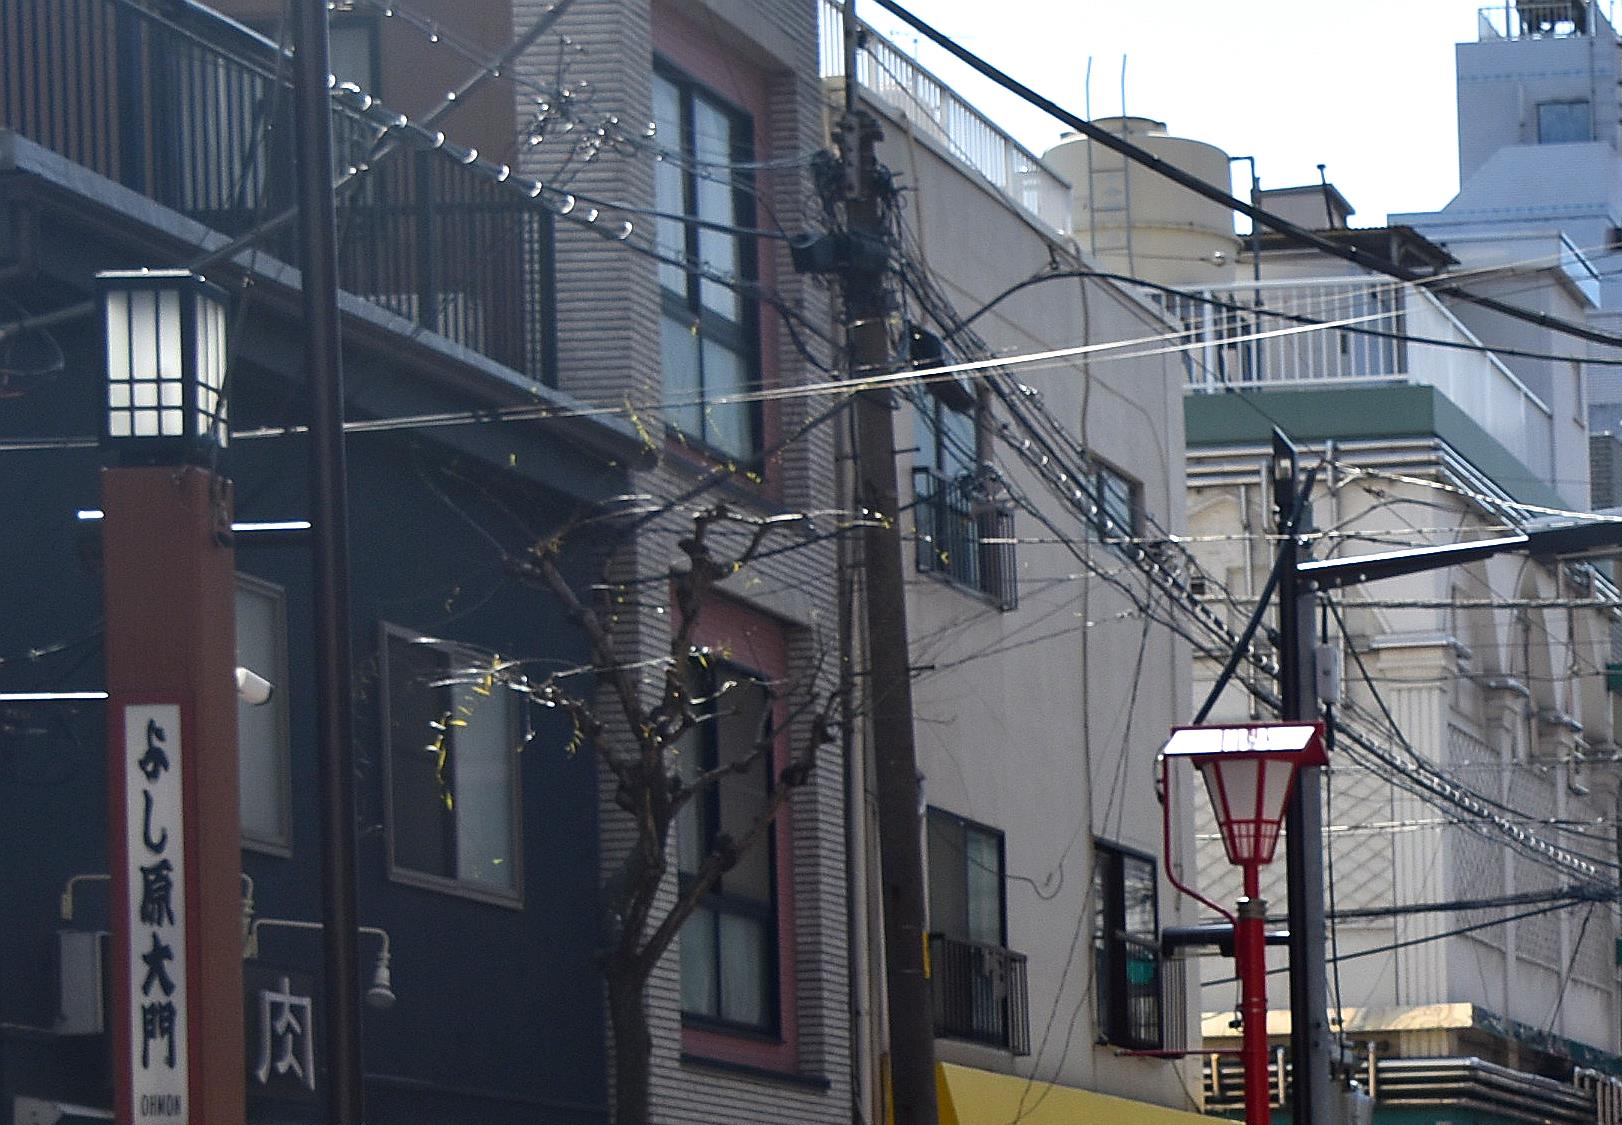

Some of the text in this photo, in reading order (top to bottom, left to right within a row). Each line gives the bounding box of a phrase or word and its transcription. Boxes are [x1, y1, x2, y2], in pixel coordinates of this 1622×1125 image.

[139, 718, 177, 1070] よし原大門
[257, 976, 317, 1092] 肉
[140, 1093, 182, 1117] OHMON
